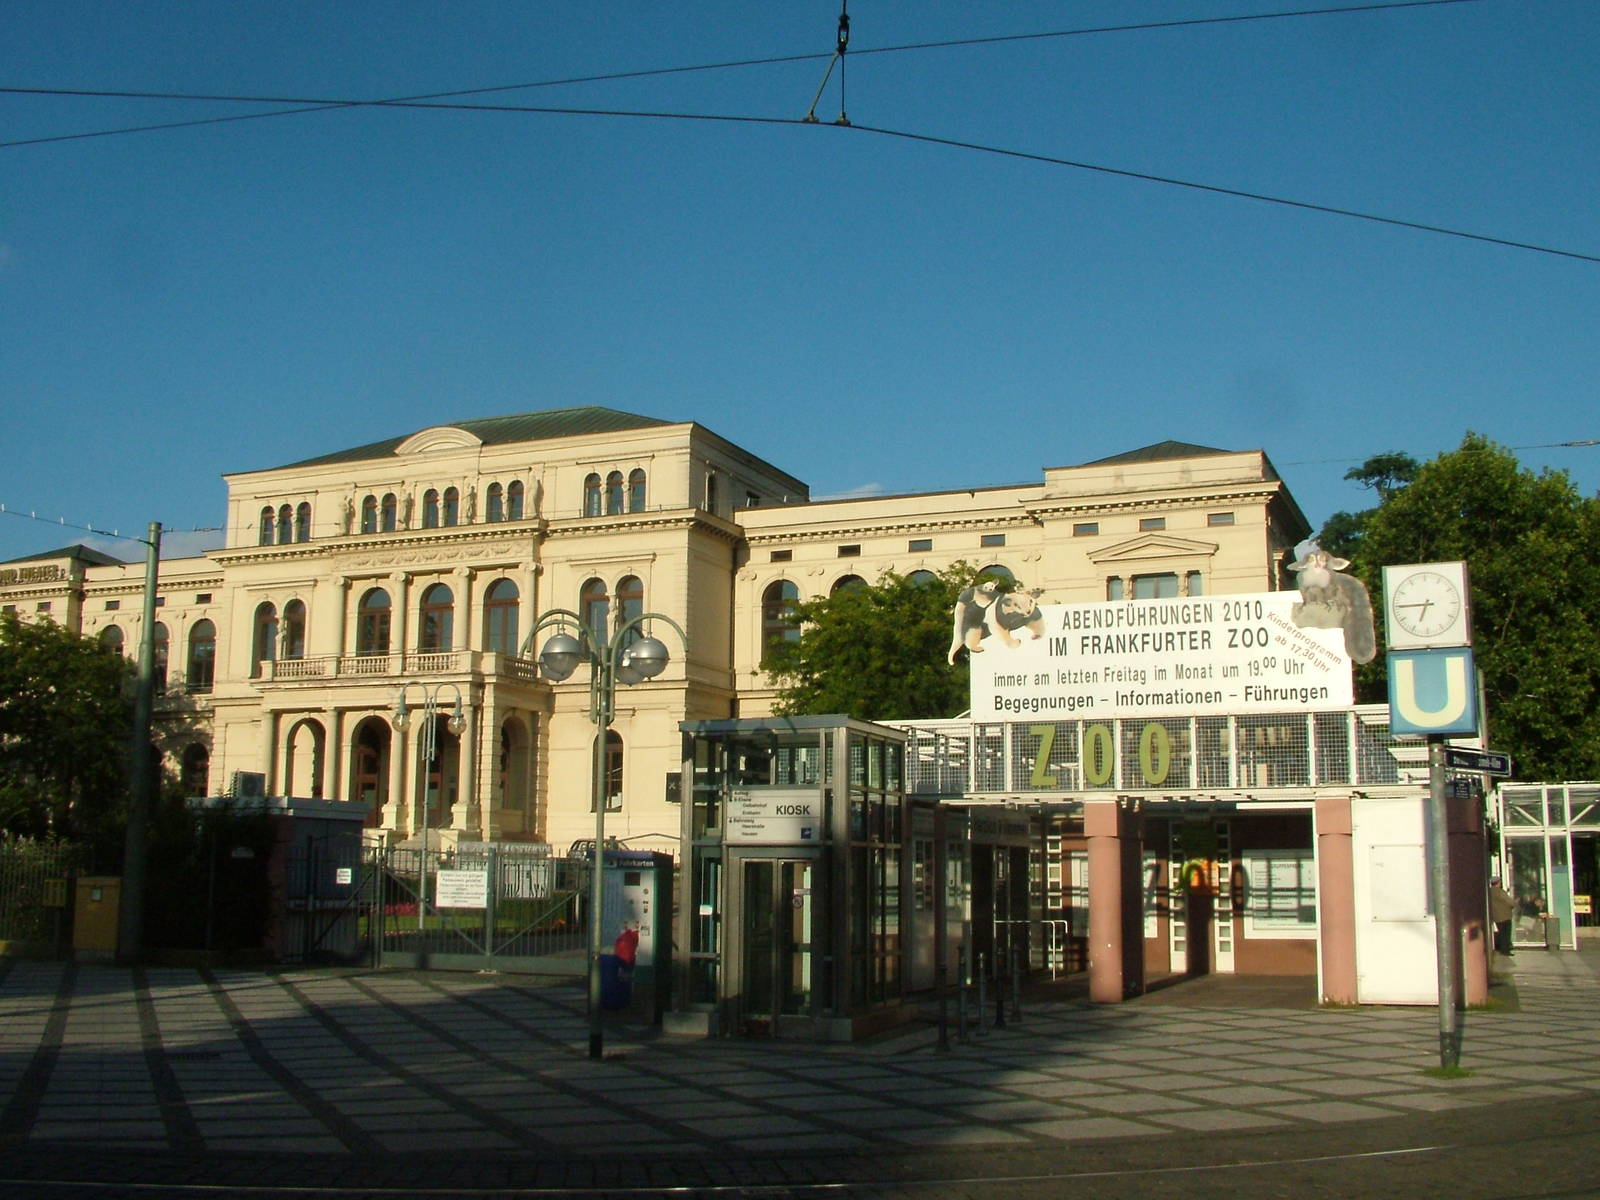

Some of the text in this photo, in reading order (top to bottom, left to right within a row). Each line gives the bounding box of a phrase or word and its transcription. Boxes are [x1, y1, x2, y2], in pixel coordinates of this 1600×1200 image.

[1062, 600, 1263, 630] ABENDFÜHRUNGEN 2010
[1049, 627, 1269, 656] IM FRANKFURTER ZOO
[1266, 611, 1342, 665] Kinderprogramm
[1274, 634, 1331, 673] ab 17.30 Uhr
[994, 672, 1028, 688] immer
[1034, 673, 1050, 686] am
[1057, 668, 1098, 685] letzten
[1104, 666, 1146, 685] Freitag
[1154, 665, 1167, 681] im
[1175, 664, 1213, 680] Monat
[1222, 665, 1239, 678] um
[1284, 658, 1304, 675] Uhr
[994, 695, 1094, 714] Begegnungen
[1115, 688, 1222, 706] Informationen
[1244, 685, 1328, 703] Führungen
[1395, 656, 1466, 728] U
[1030, 722, 1170, 787] ZOO
[776, 804, 811, 816] KIOSK
